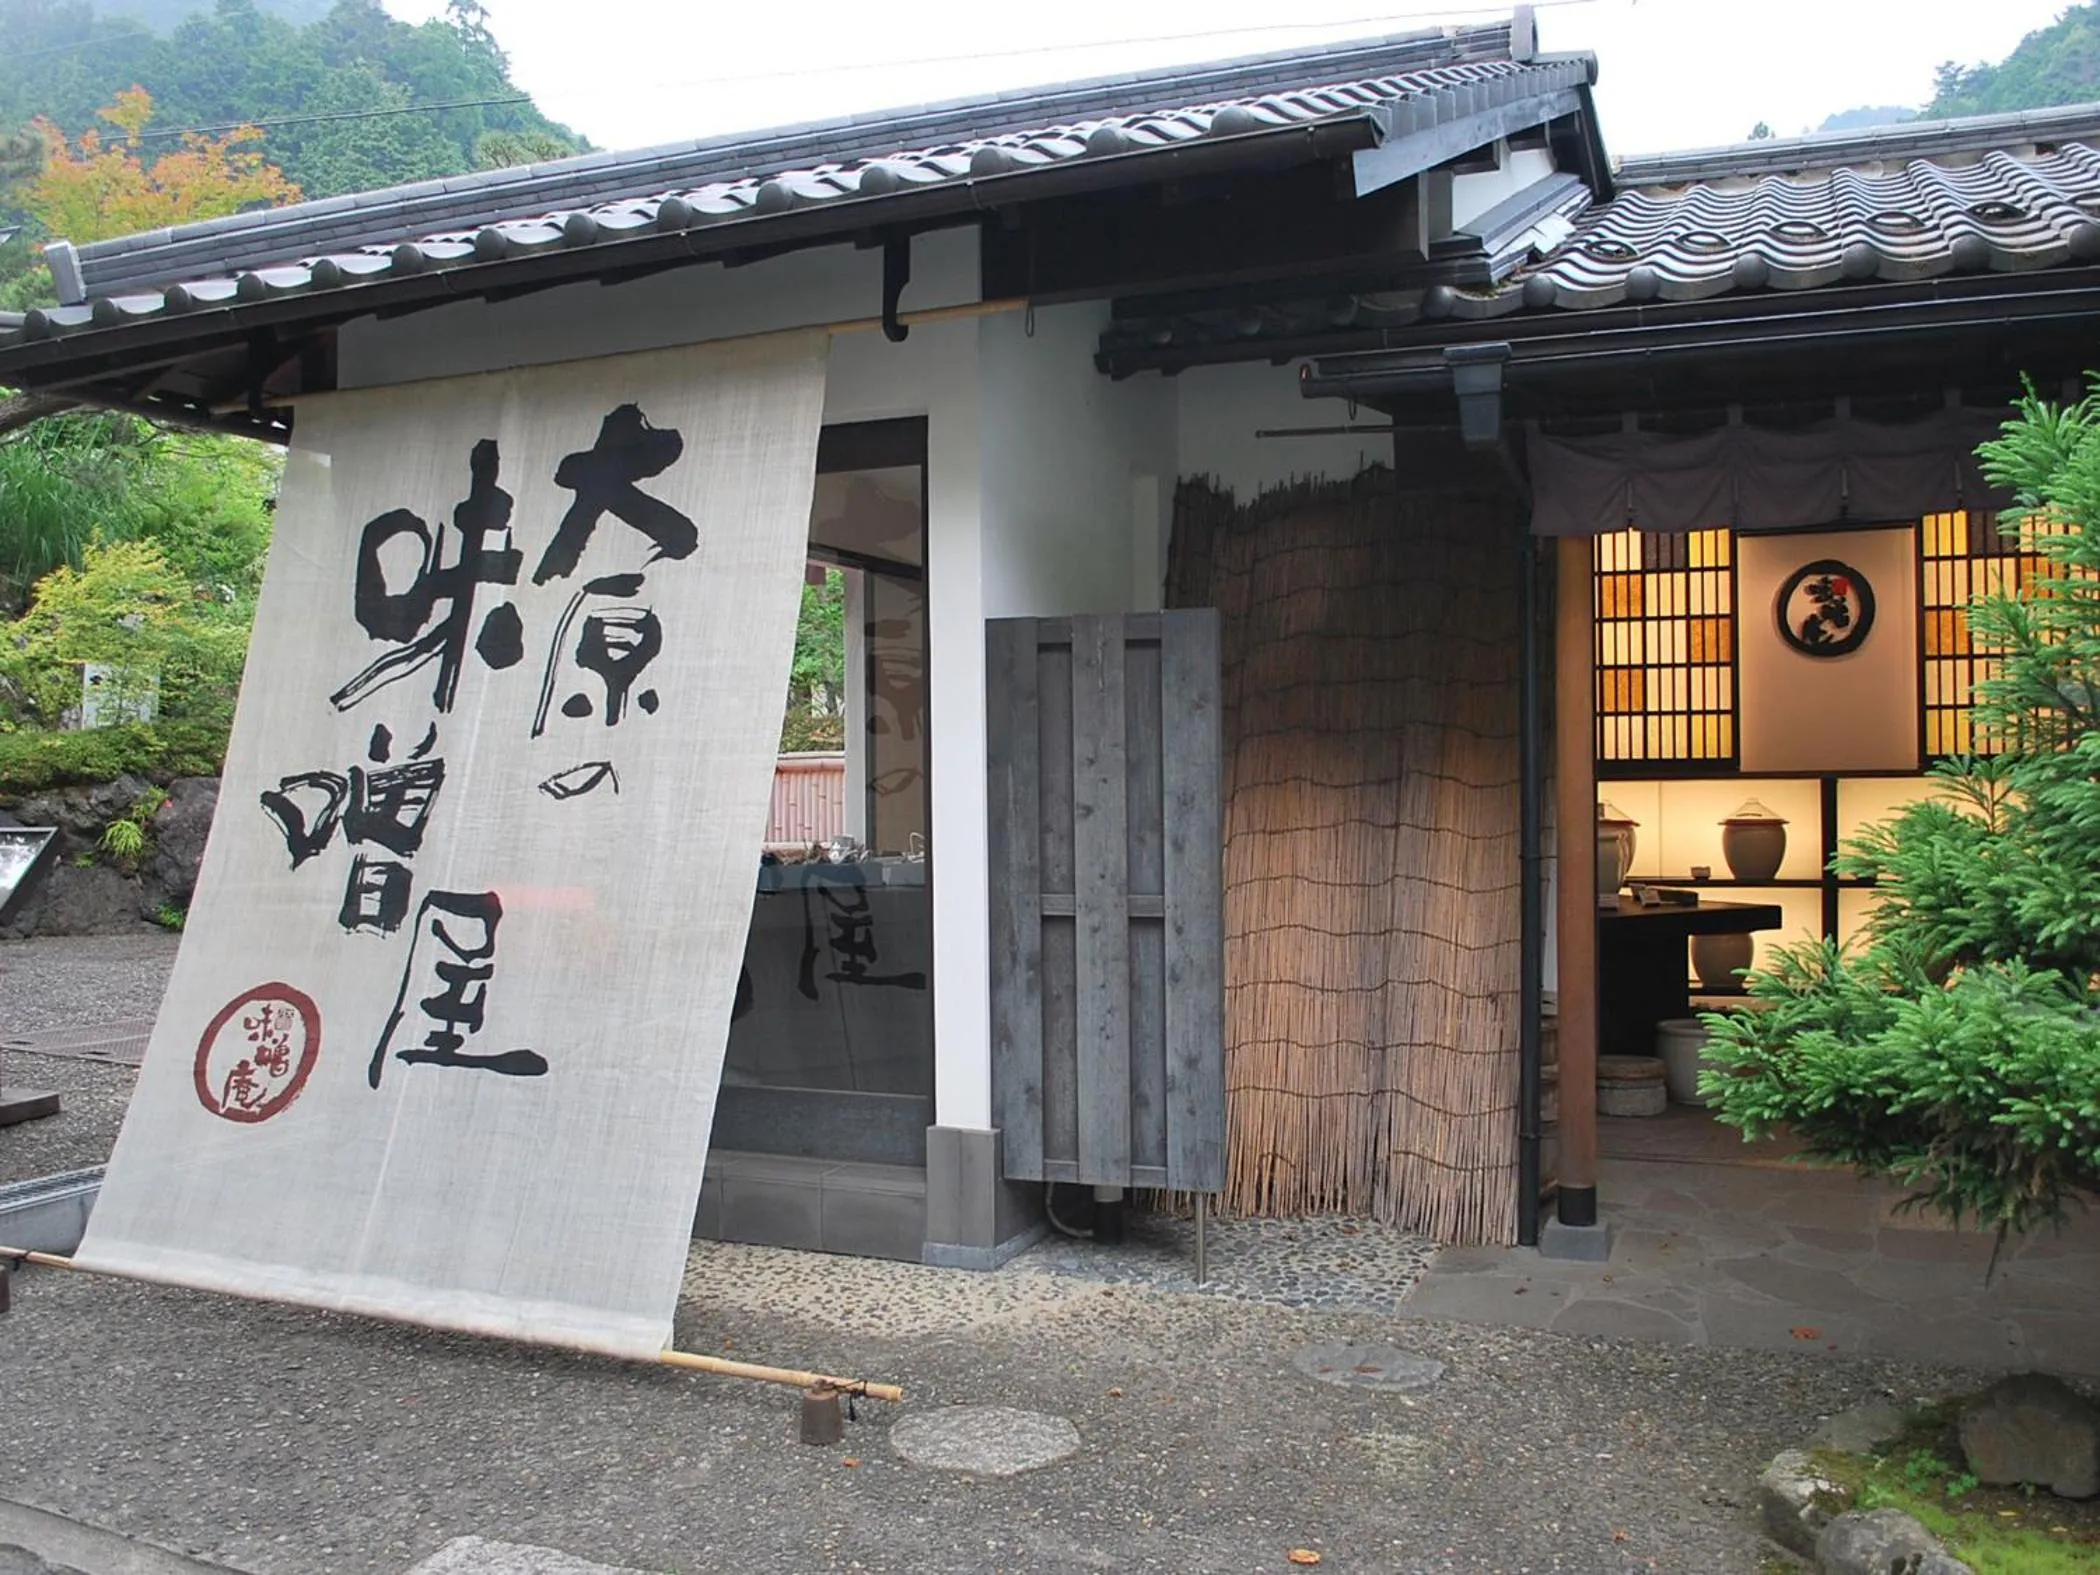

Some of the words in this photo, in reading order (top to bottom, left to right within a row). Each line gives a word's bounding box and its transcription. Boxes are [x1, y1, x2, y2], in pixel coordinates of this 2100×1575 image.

[260, 438, 548, 1090] 味噌屋
[532, 402, 699, 800] 大原の
